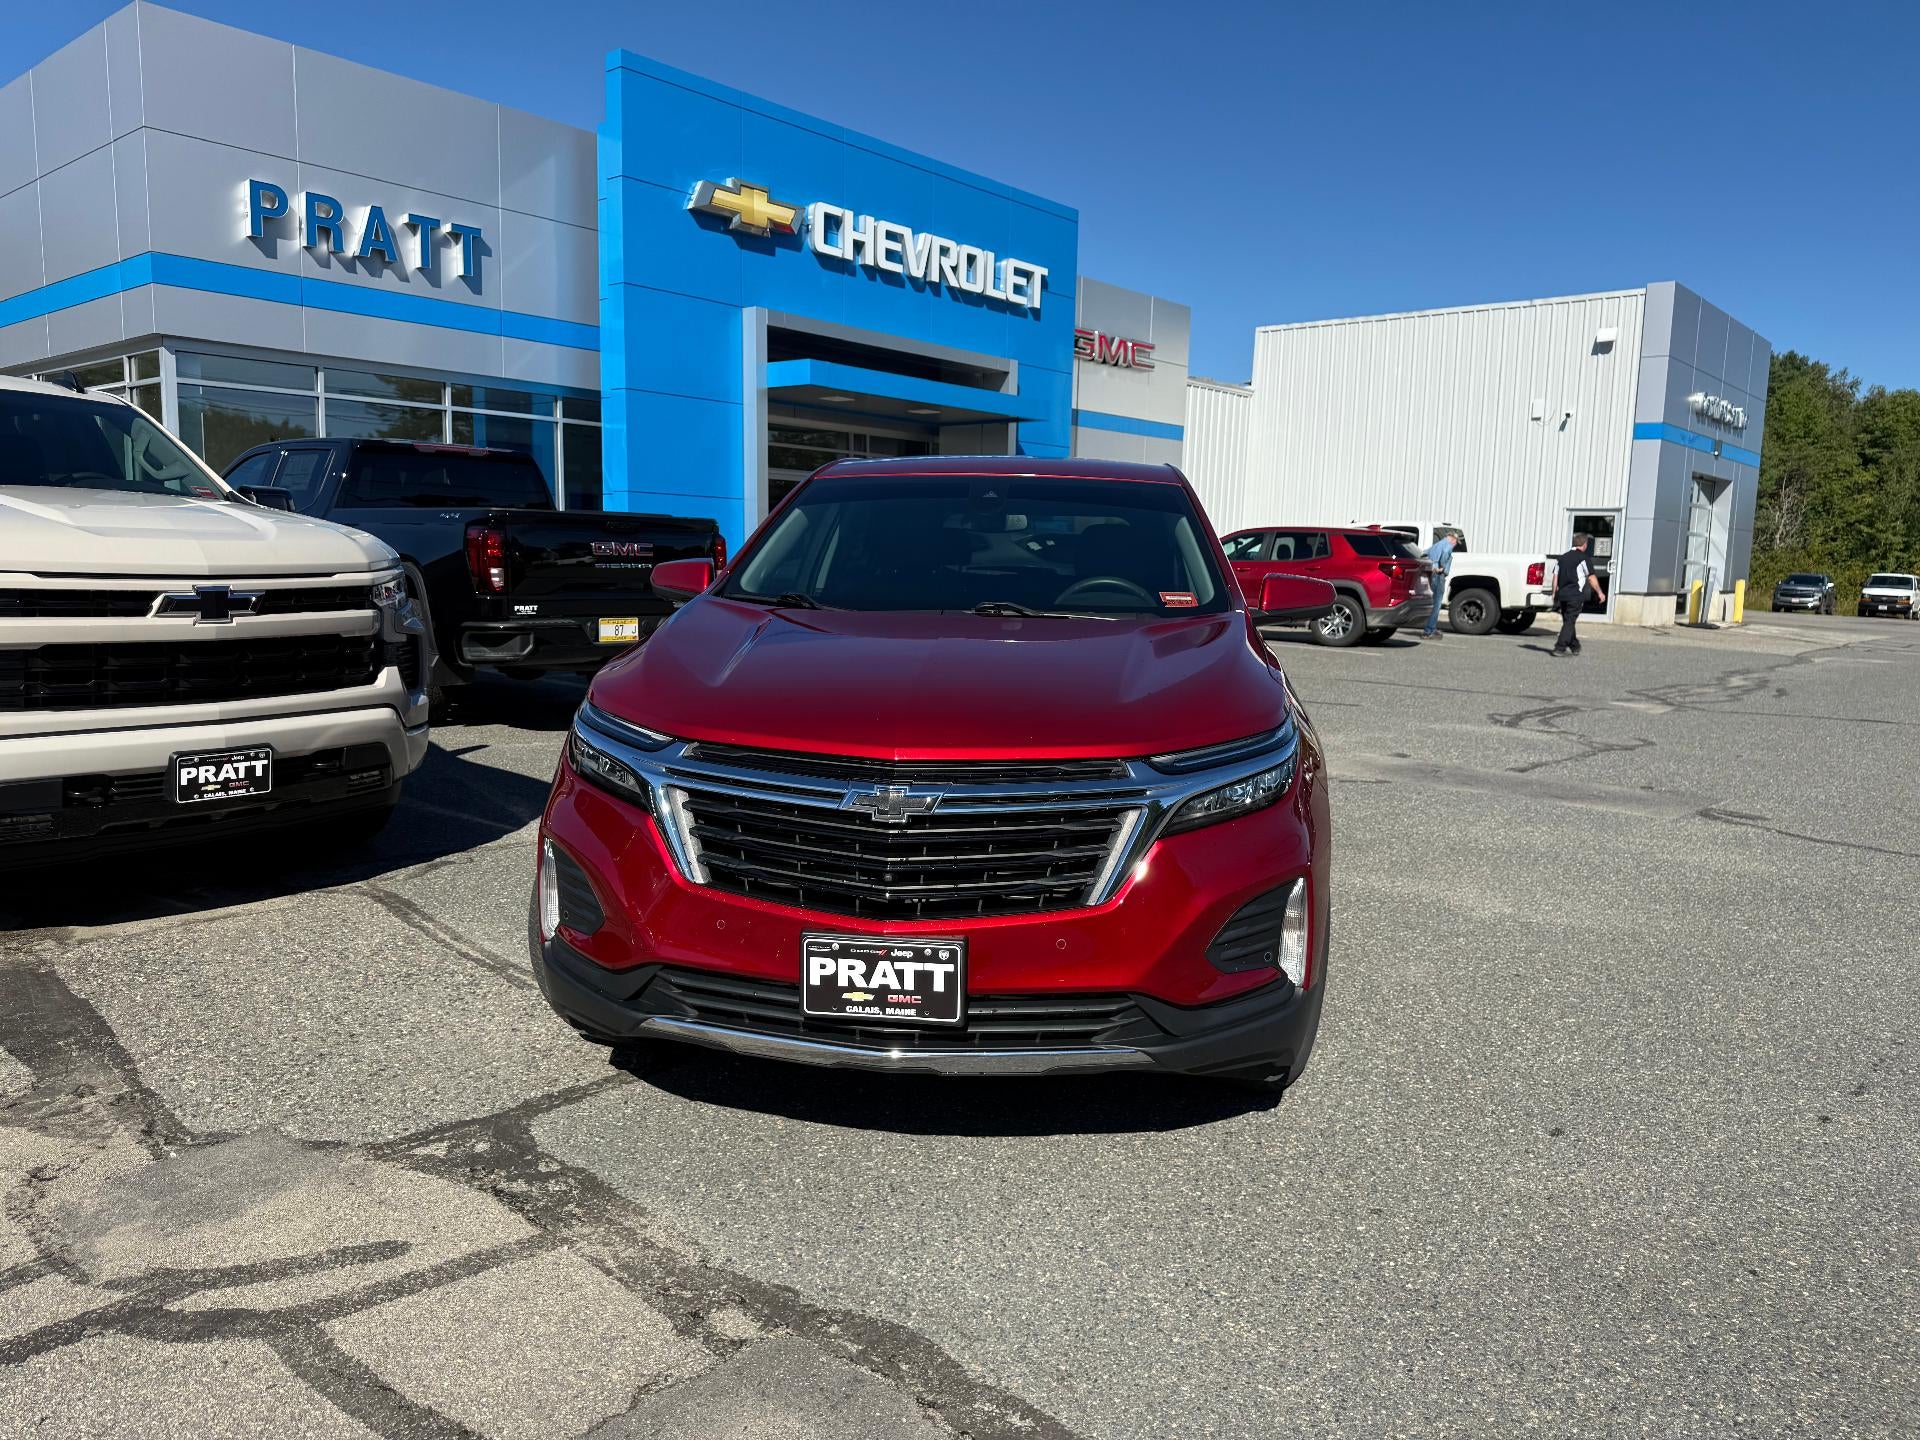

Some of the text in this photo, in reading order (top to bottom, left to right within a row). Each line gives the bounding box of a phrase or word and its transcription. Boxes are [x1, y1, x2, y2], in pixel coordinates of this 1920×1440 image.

[244, 178, 482, 277] PRATT
[808, 201, 1048, 309] CHEVROLET
[1074, 328, 1155, 369] GMC
[591, 541, 653, 557] GMC
[614, 624, 625, 637] 87
[180, 760, 268, 785] PRATT
[890, 948, 914, 959] Jeep
[809, 956, 955, 992] PRATT
[887, 994, 922, 1004] GMC
[845, 1005, 917, 1016] CALAIS, MAINE
